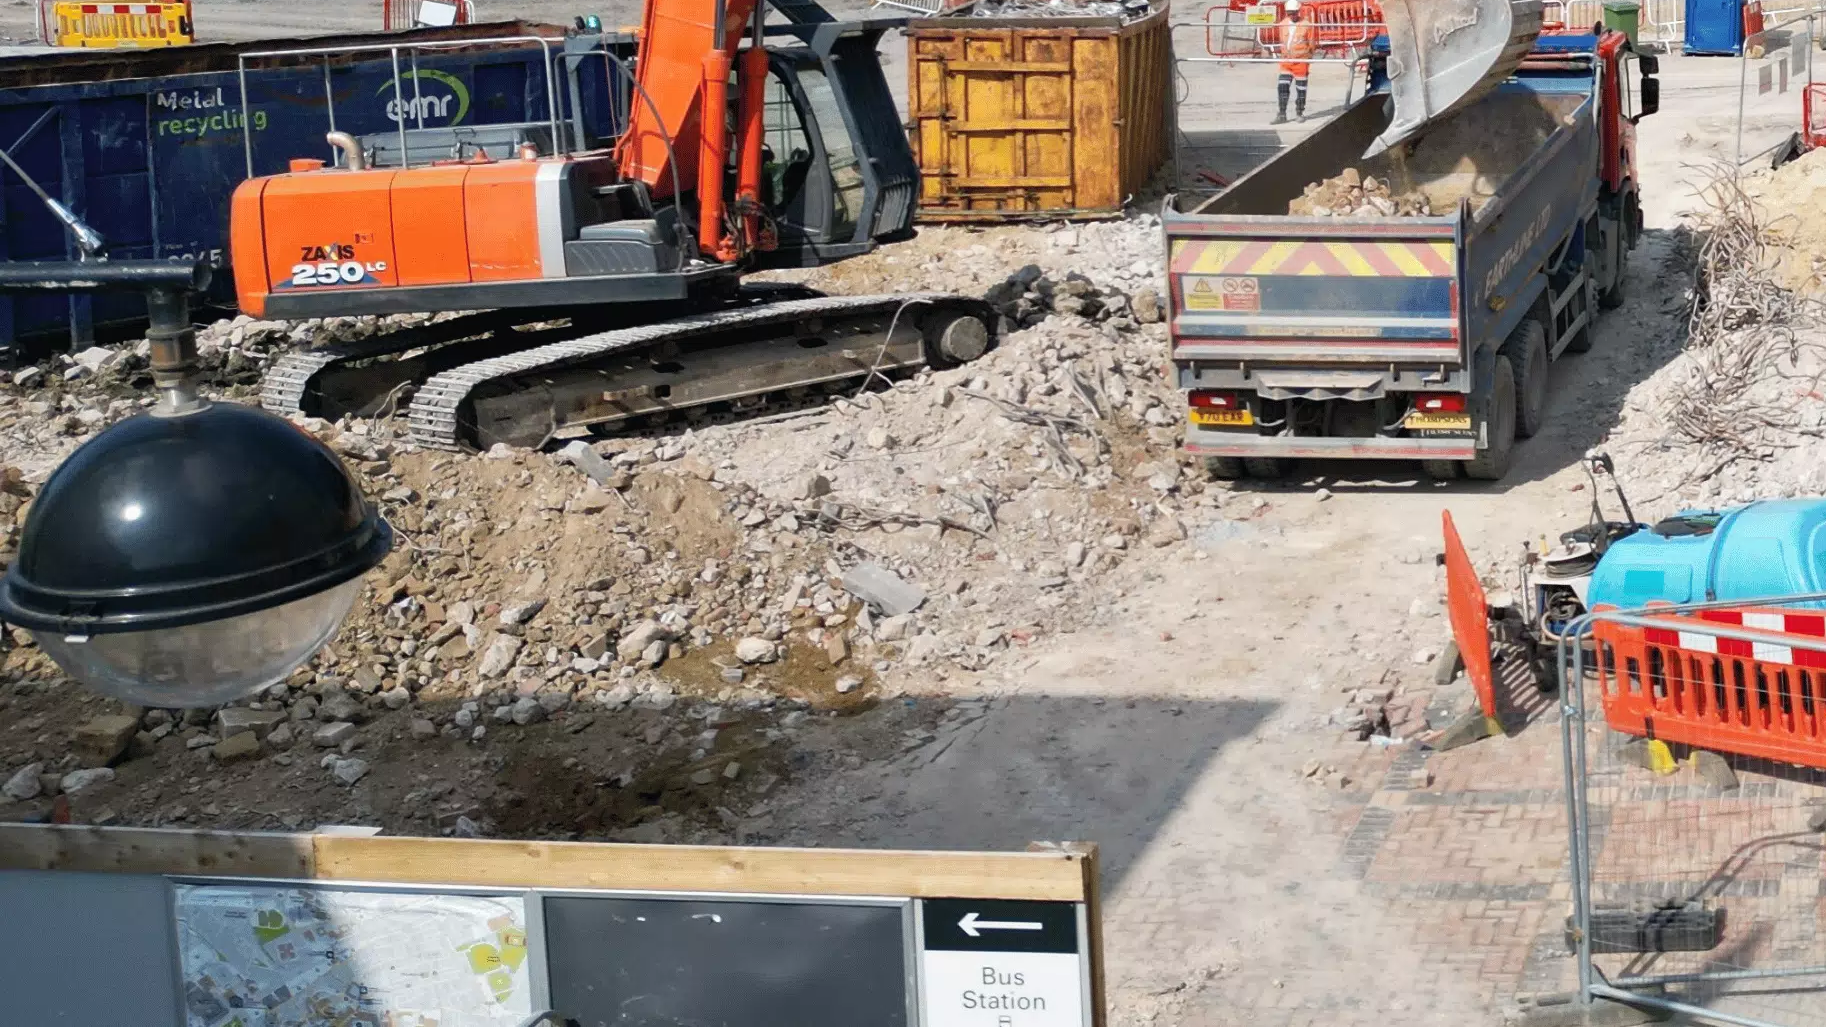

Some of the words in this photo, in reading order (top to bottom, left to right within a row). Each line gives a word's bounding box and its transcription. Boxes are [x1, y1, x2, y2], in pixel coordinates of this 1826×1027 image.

[386, 94, 453, 122] emr
[300, 241, 356, 262] ZAXIS
[291, 261, 365, 286] 250
[365, 261, 387, 272] LC
[982, 966, 1025, 986] Bus
[962, 989, 1046, 1011] Station
